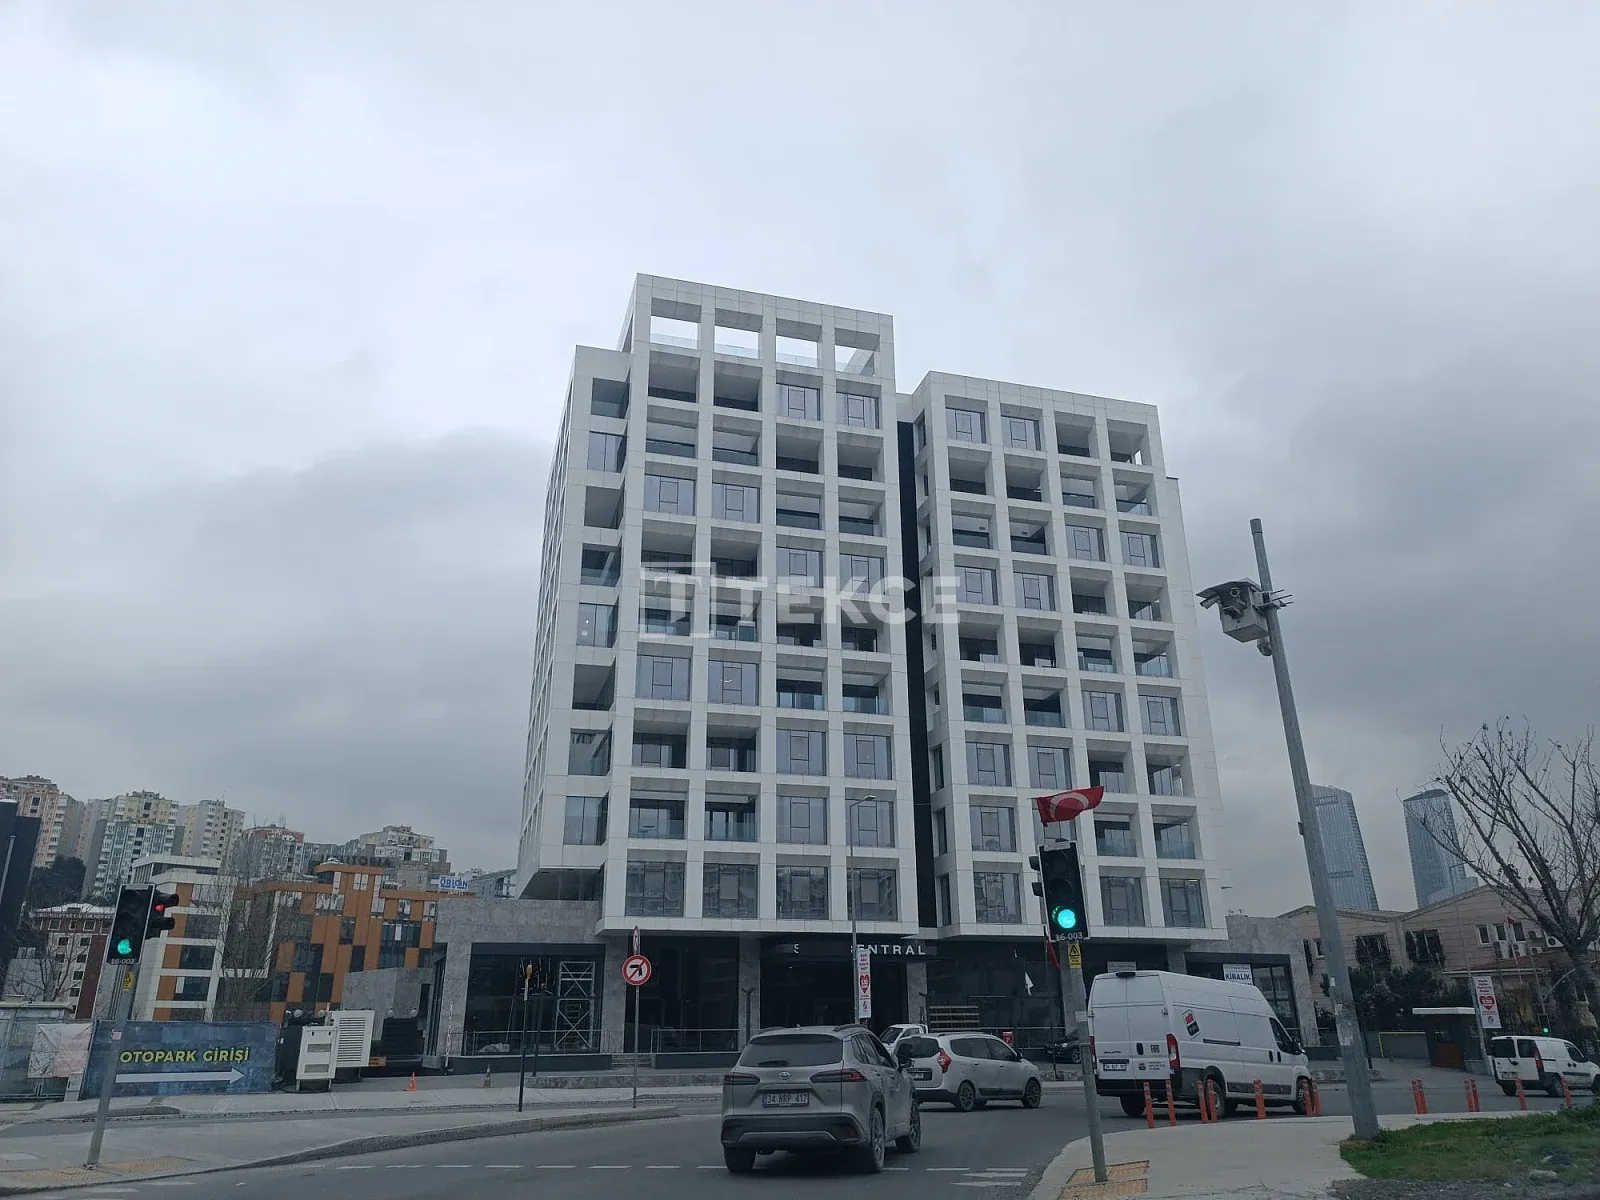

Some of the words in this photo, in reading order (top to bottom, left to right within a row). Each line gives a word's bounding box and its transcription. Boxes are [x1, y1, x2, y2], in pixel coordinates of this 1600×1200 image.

[1055, 931, 1083, 941] 16-003
[119, 1050, 197, 1063] OTOPARK
[203, 1047, 250, 1064] GİRİŞİ
